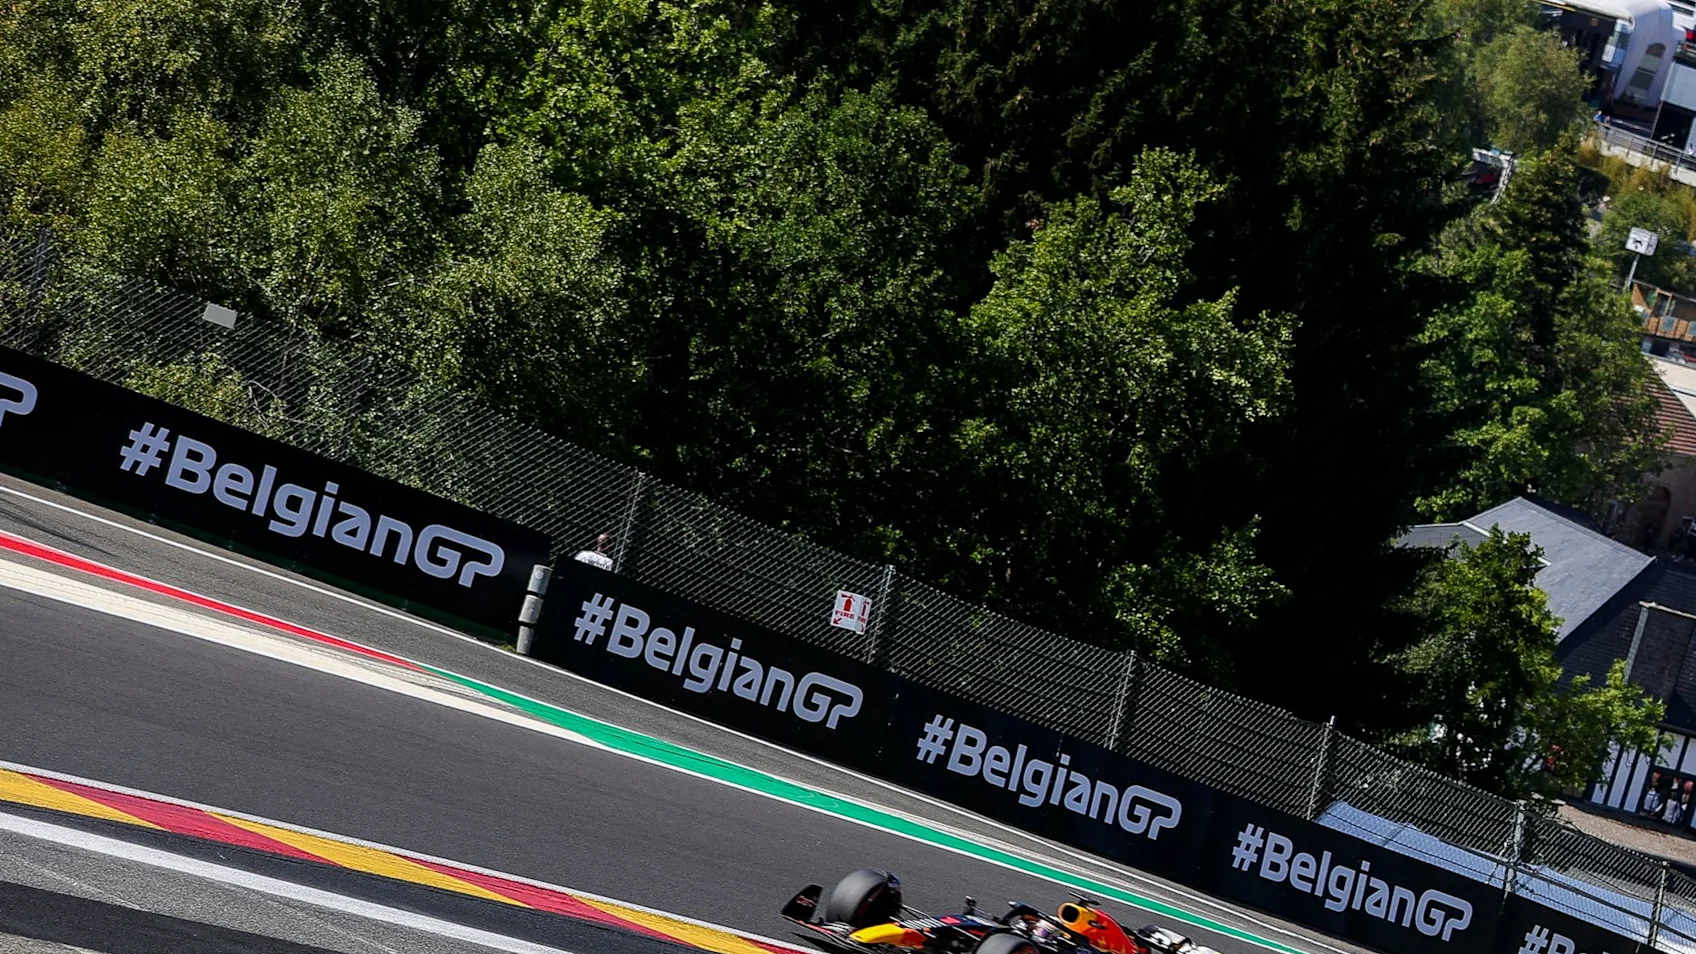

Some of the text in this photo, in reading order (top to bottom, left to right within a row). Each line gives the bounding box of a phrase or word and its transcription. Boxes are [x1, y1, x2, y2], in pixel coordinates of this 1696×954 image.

[119, 421, 505, 588] #BelgianGP
[573, 592, 864, 730] #BelgianGP
[916, 714, 1182, 841] #BelgianGP
[1231, 823, 1473, 942] #BelgianGP
